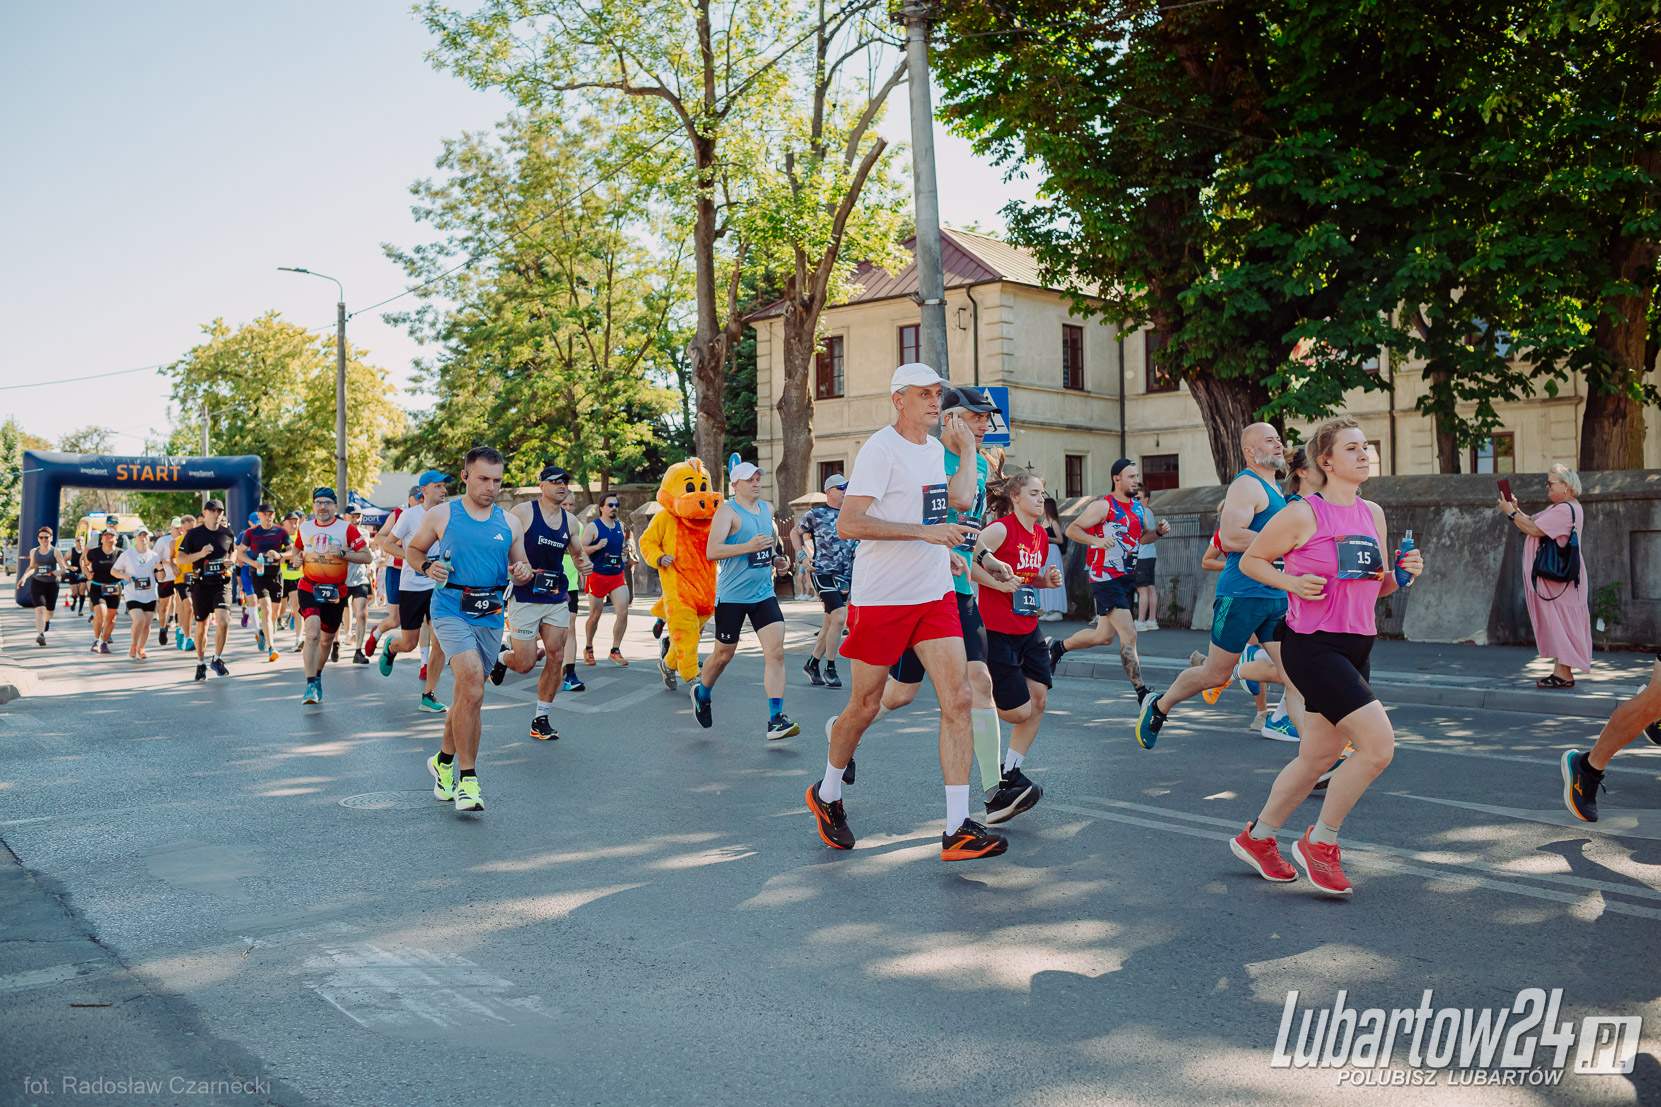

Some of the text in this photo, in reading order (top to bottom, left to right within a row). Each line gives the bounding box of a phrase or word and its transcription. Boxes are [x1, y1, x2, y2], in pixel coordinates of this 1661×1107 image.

[116, 464, 181, 481] START
[931, 498, 947, 511] 132
[361, 515, 380, 523] port
[756, 551, 770, 560] 124
[1357, 551, 1371, 565] 15
[544, 579, 554, 587] 71
[474, 599, 489, 610] 49
